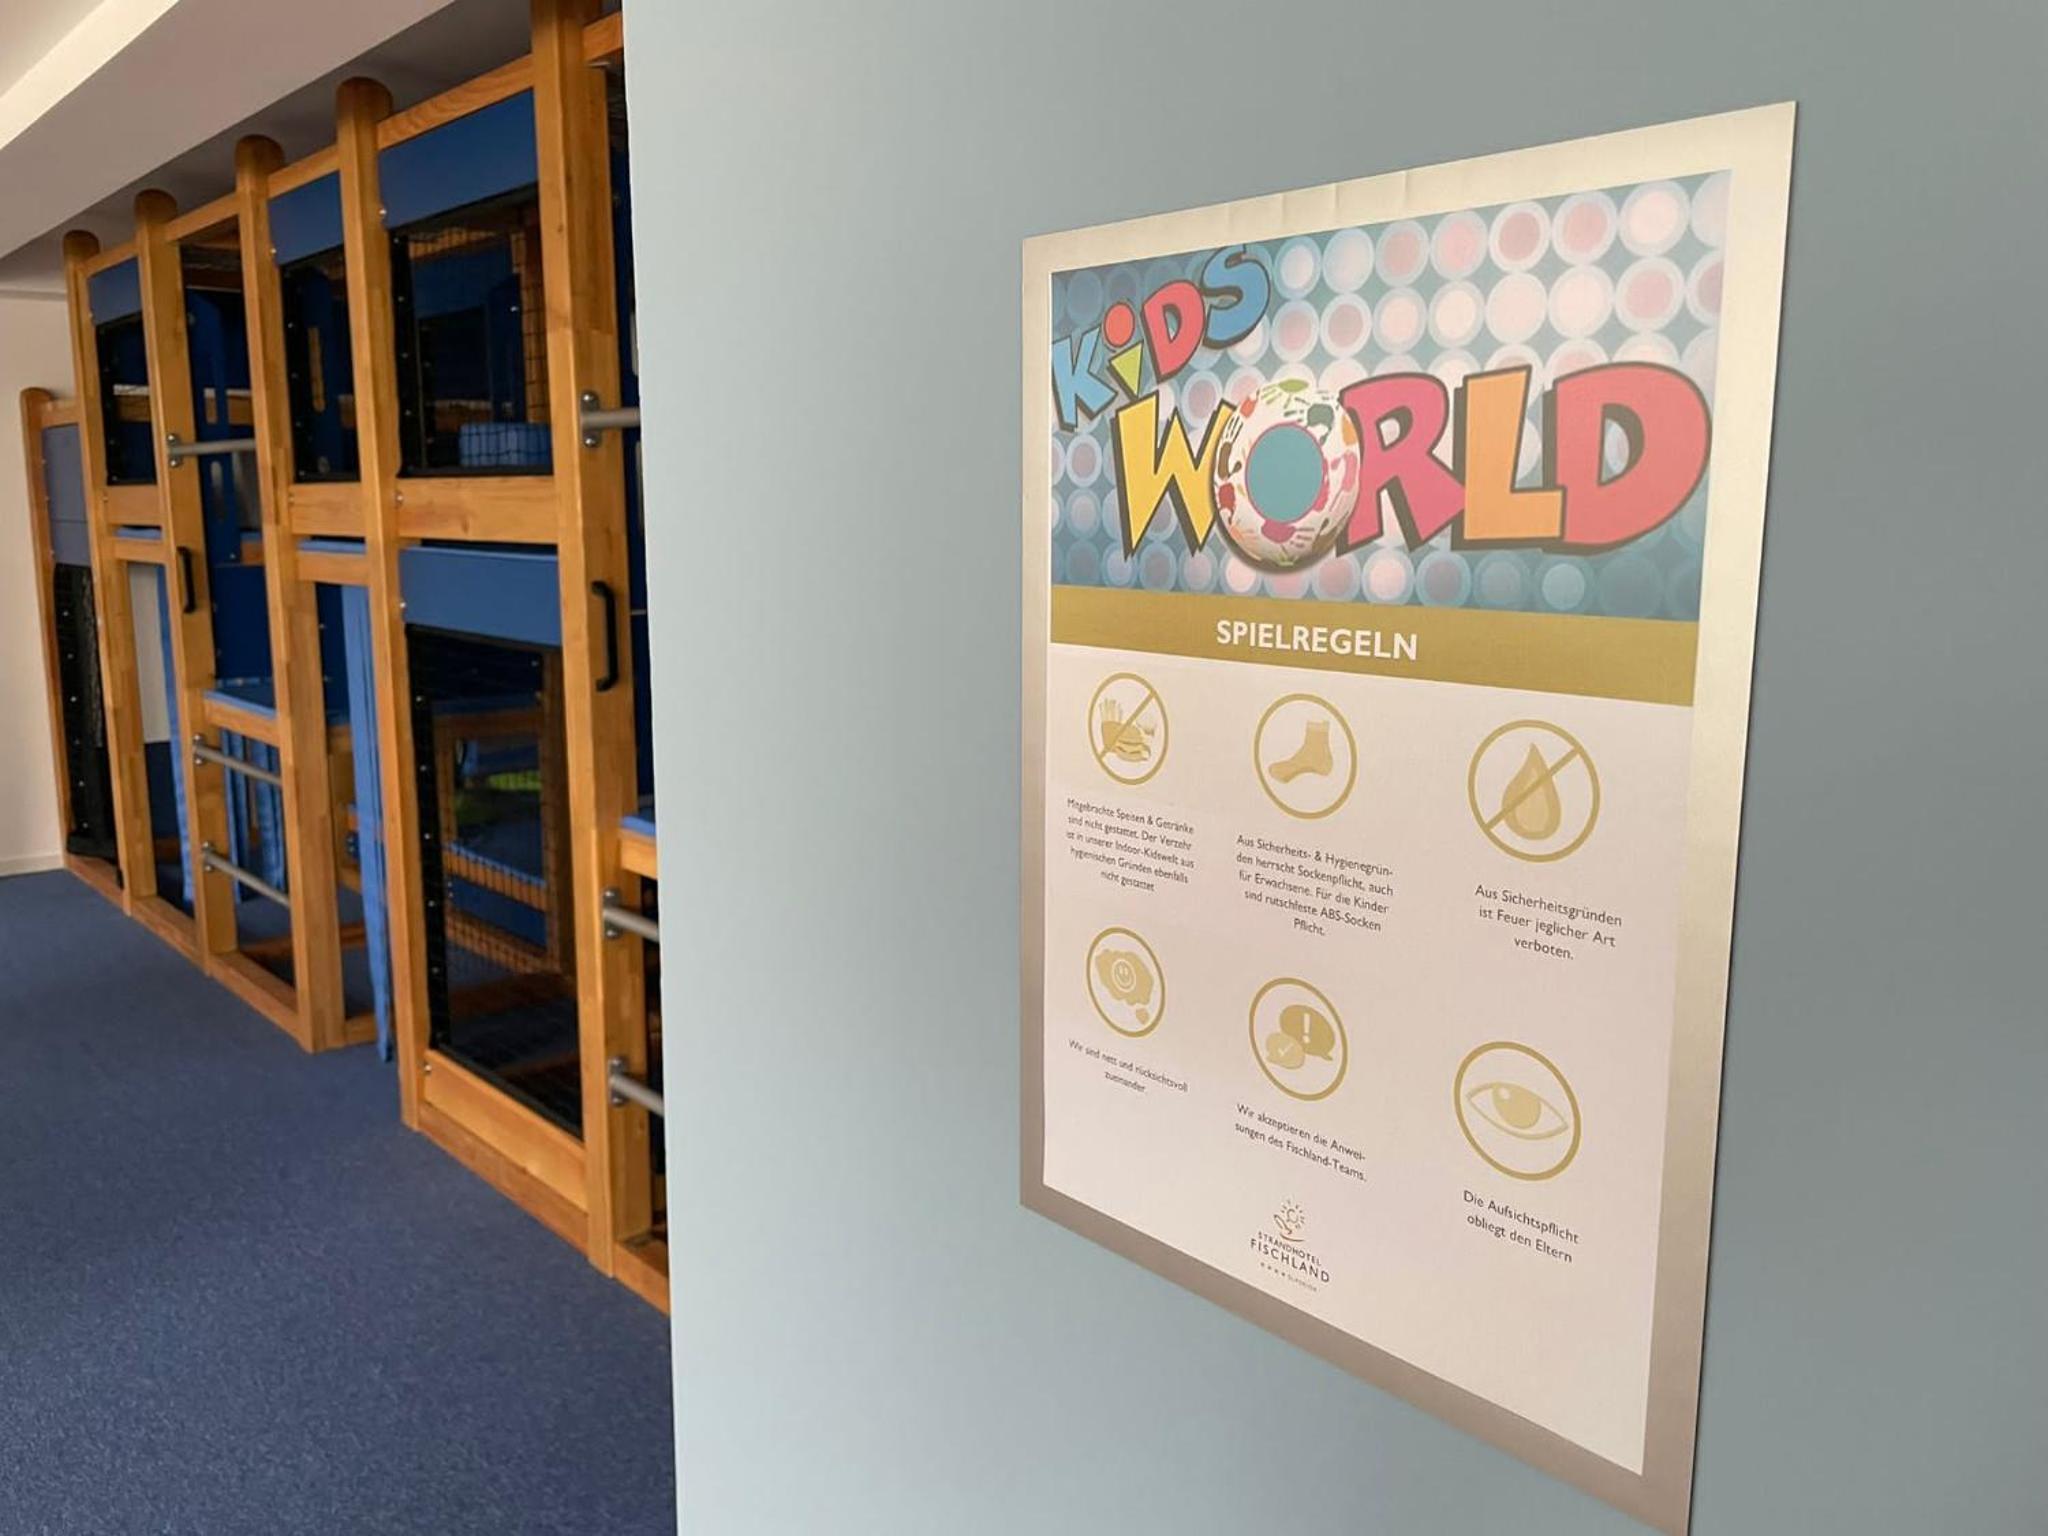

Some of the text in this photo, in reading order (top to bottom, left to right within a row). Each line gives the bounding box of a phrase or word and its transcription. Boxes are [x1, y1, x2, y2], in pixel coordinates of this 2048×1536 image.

[1112, 361, 1712, 574] WORLD
[1216, 618, 1419, 663] SPIELREGELN
[1068, 816, 1083, 827] sind
[1085, 818, 1102, 831] nicht
[1141, 831, 1157, 842] Der
[1160, 835, 1192, 851] Verzehr
[1117, 808, 1145, 824] Speisen
[1147, 815, 1153, 825] &
[1070, 846, 1116, 866] hygienischen
[1154, 868, 1188, 883] ebenfalls
[1076, 832, 1083, 841] in
[1085, 835, 1113, 848] unserer
[1115, 840, 1179, 864] Indoor-Kidswelt
[1181, 859, 1194, 869] aus
[1236, 834, 1254, 847] Aus
[1257, 838, 1311, 859] Sicherheits-
[1314, 851, 1322, 861] &
[1101, 870, 1119, 882] nicht
[1236, 852, 1393, 897] den herrscht Sockenpflicht, auch
[1239, 870, 1390, 913] für Erwachsene. Für die Kinder
[1245, 890, 1381, 932] sind rutschfeste ABS-Socken
[1475, 884, 1622, 927] Aus Sicherheitsgründen
[1479, 905, 1616, 948] ist Feuer jeglicher Art
[1293, 918, 1325, 936] Pflicht.
[1514, 937, 1574, 960] verboten.
[1069, 1040, 1082, 1051] Wir
[1085, 1048, 1100, 1059] sind
[1102, 1054, 1117, 1066] nett
[1119, 1060, 1133, 1072] und
[1235, 1123, 1367, 1182] sungen des Fischland-Teams.
[1237, 1104, 1366, 1161] Wir akzeptieren die Anwei-
[1464, 1190, 1580, 1244] Die Aufsichtspflicht
[1258, 1231, 1321, 1266] STRANDHOTEL
[1467, 1215, 1572, 1263] obliegt den Eltern
[1251, 1238, 1329, 1283] FISCHLAND
